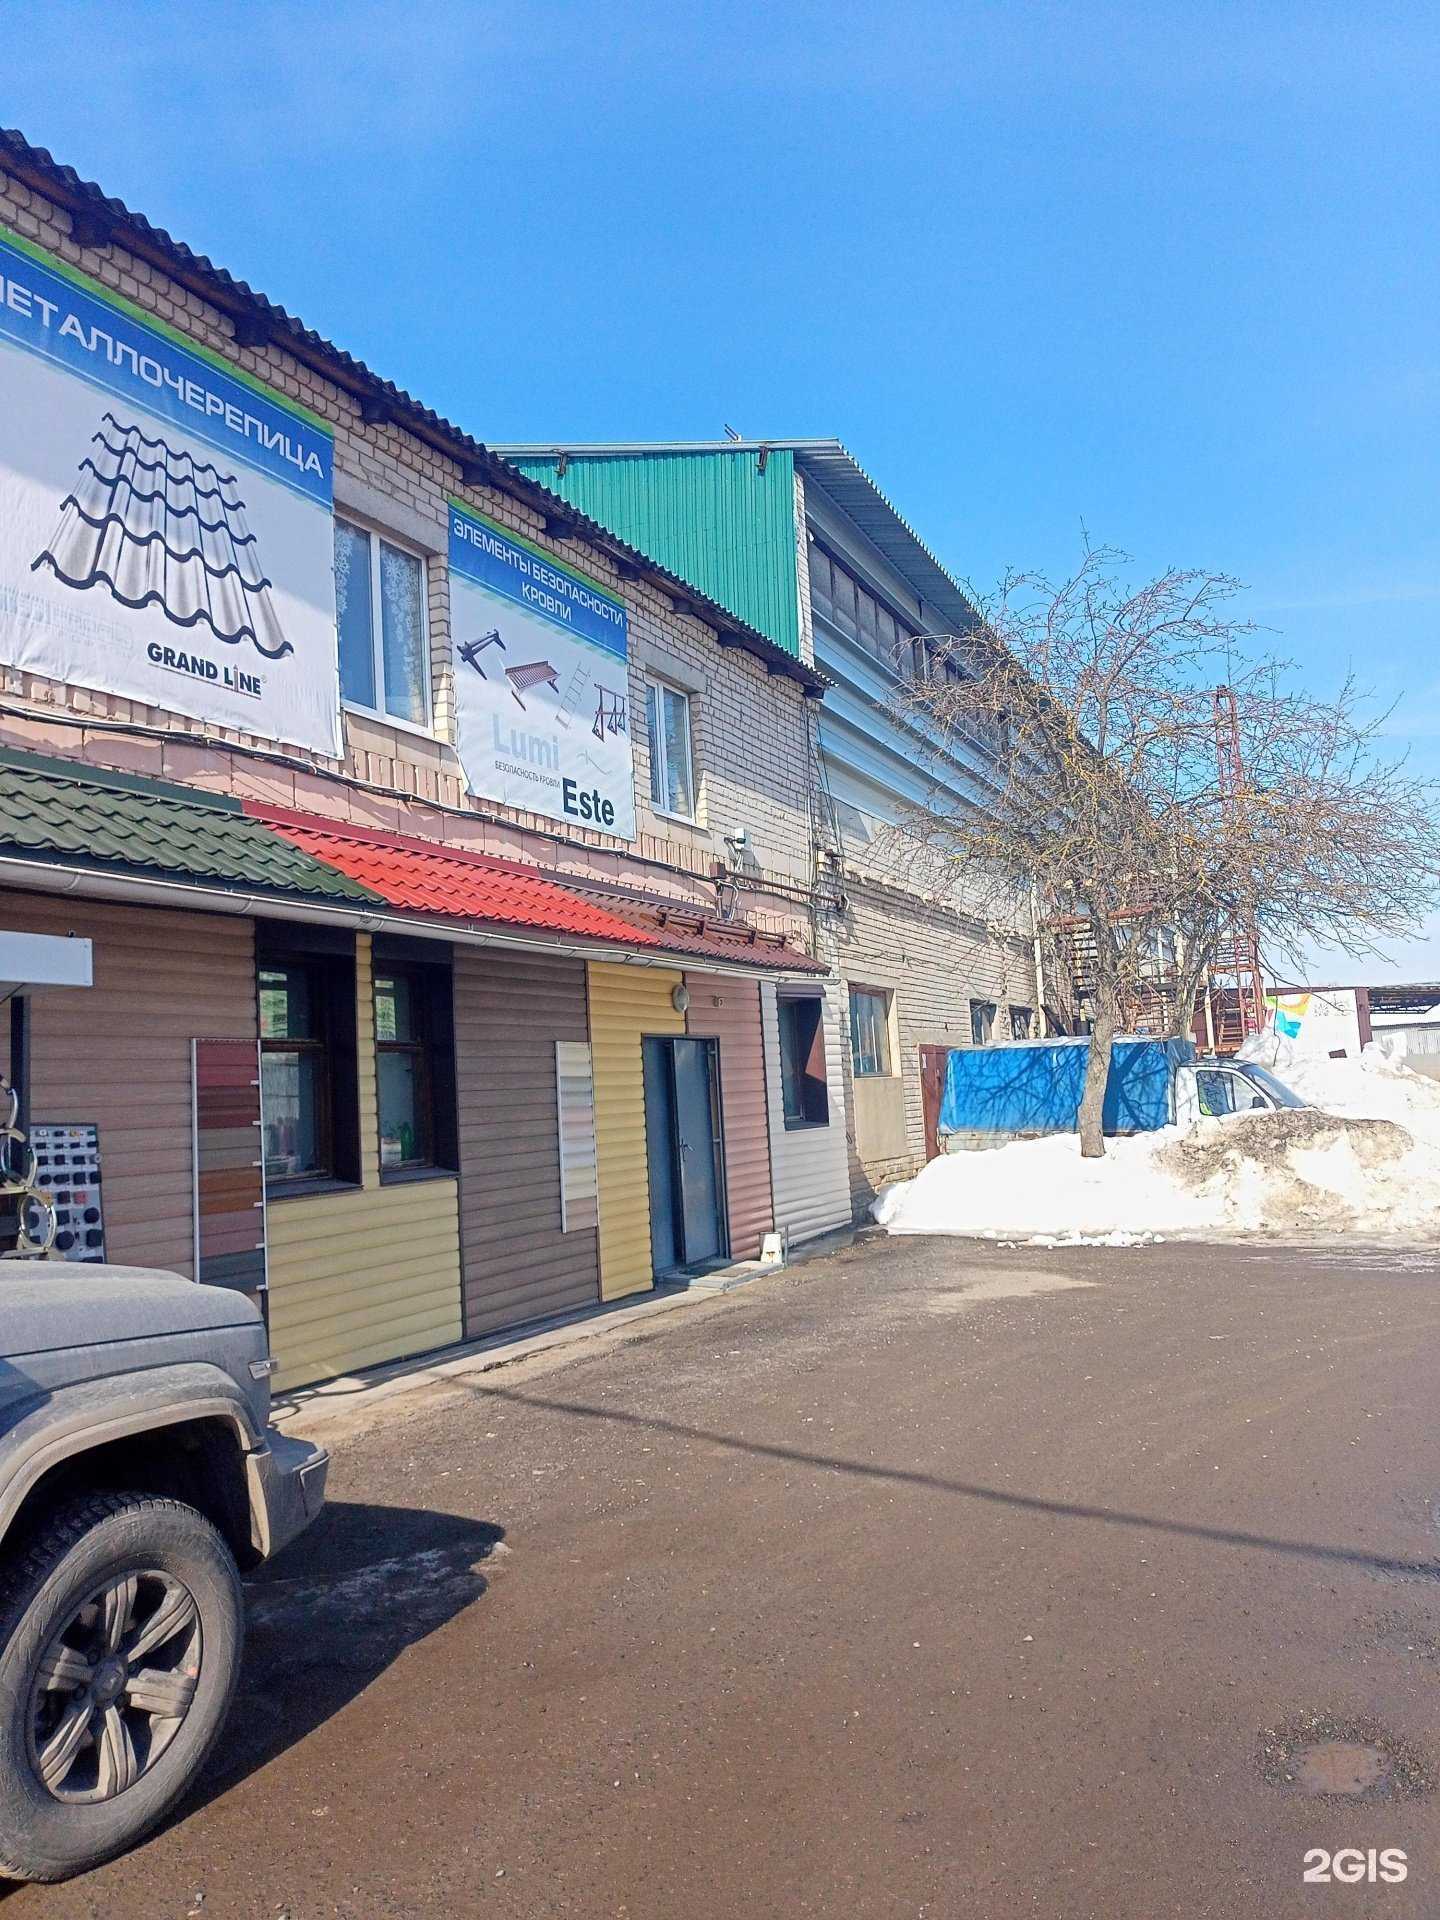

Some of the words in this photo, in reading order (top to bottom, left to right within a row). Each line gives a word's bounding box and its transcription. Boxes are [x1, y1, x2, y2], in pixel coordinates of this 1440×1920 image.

[0, 274, 325, 479] ЕТАЛЛОЧЕРЕПИЦА
[453, 517, 531, 576] ЭЛЕМЕНТЫ
[532, 564, 624, 628] БЕЗОПАСНОСТИ
[521, 582, 572, 622] КРОВЛИ
[147, 642, 218, 680] GRAND
[492, 713, 560, 771] Lumi
[494, 760, 539, 783] БЕЗОПАСНОСТЬ
[562, 777, 615, 826] Este
